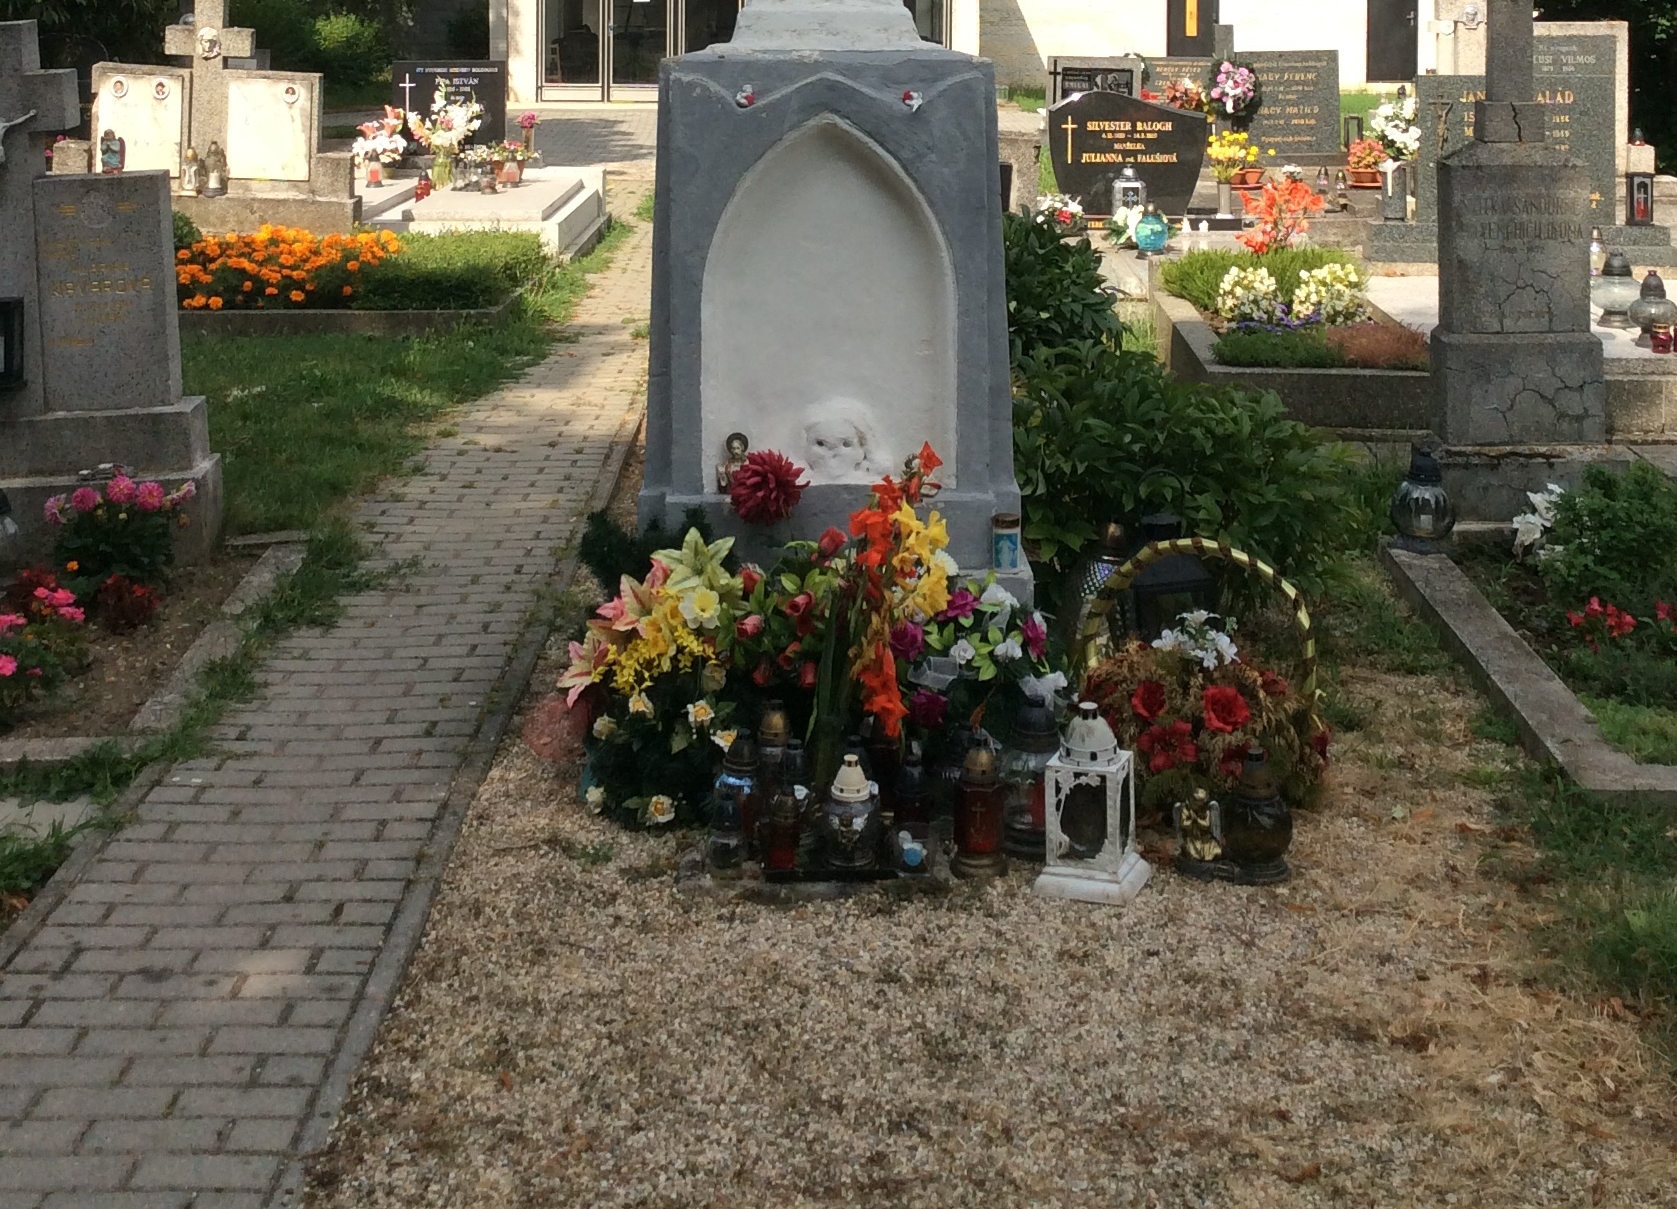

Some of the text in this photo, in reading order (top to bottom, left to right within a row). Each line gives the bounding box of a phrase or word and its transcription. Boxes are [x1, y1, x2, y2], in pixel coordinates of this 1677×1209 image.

[1560, 55, 1596, 64] VILMOS
[1535, 87, 1574, 104] ALÁD
[1086, 121, 1173, 131] SILVESTER BALOGH
[1080, 153, 1124, 163] JULIANNA
